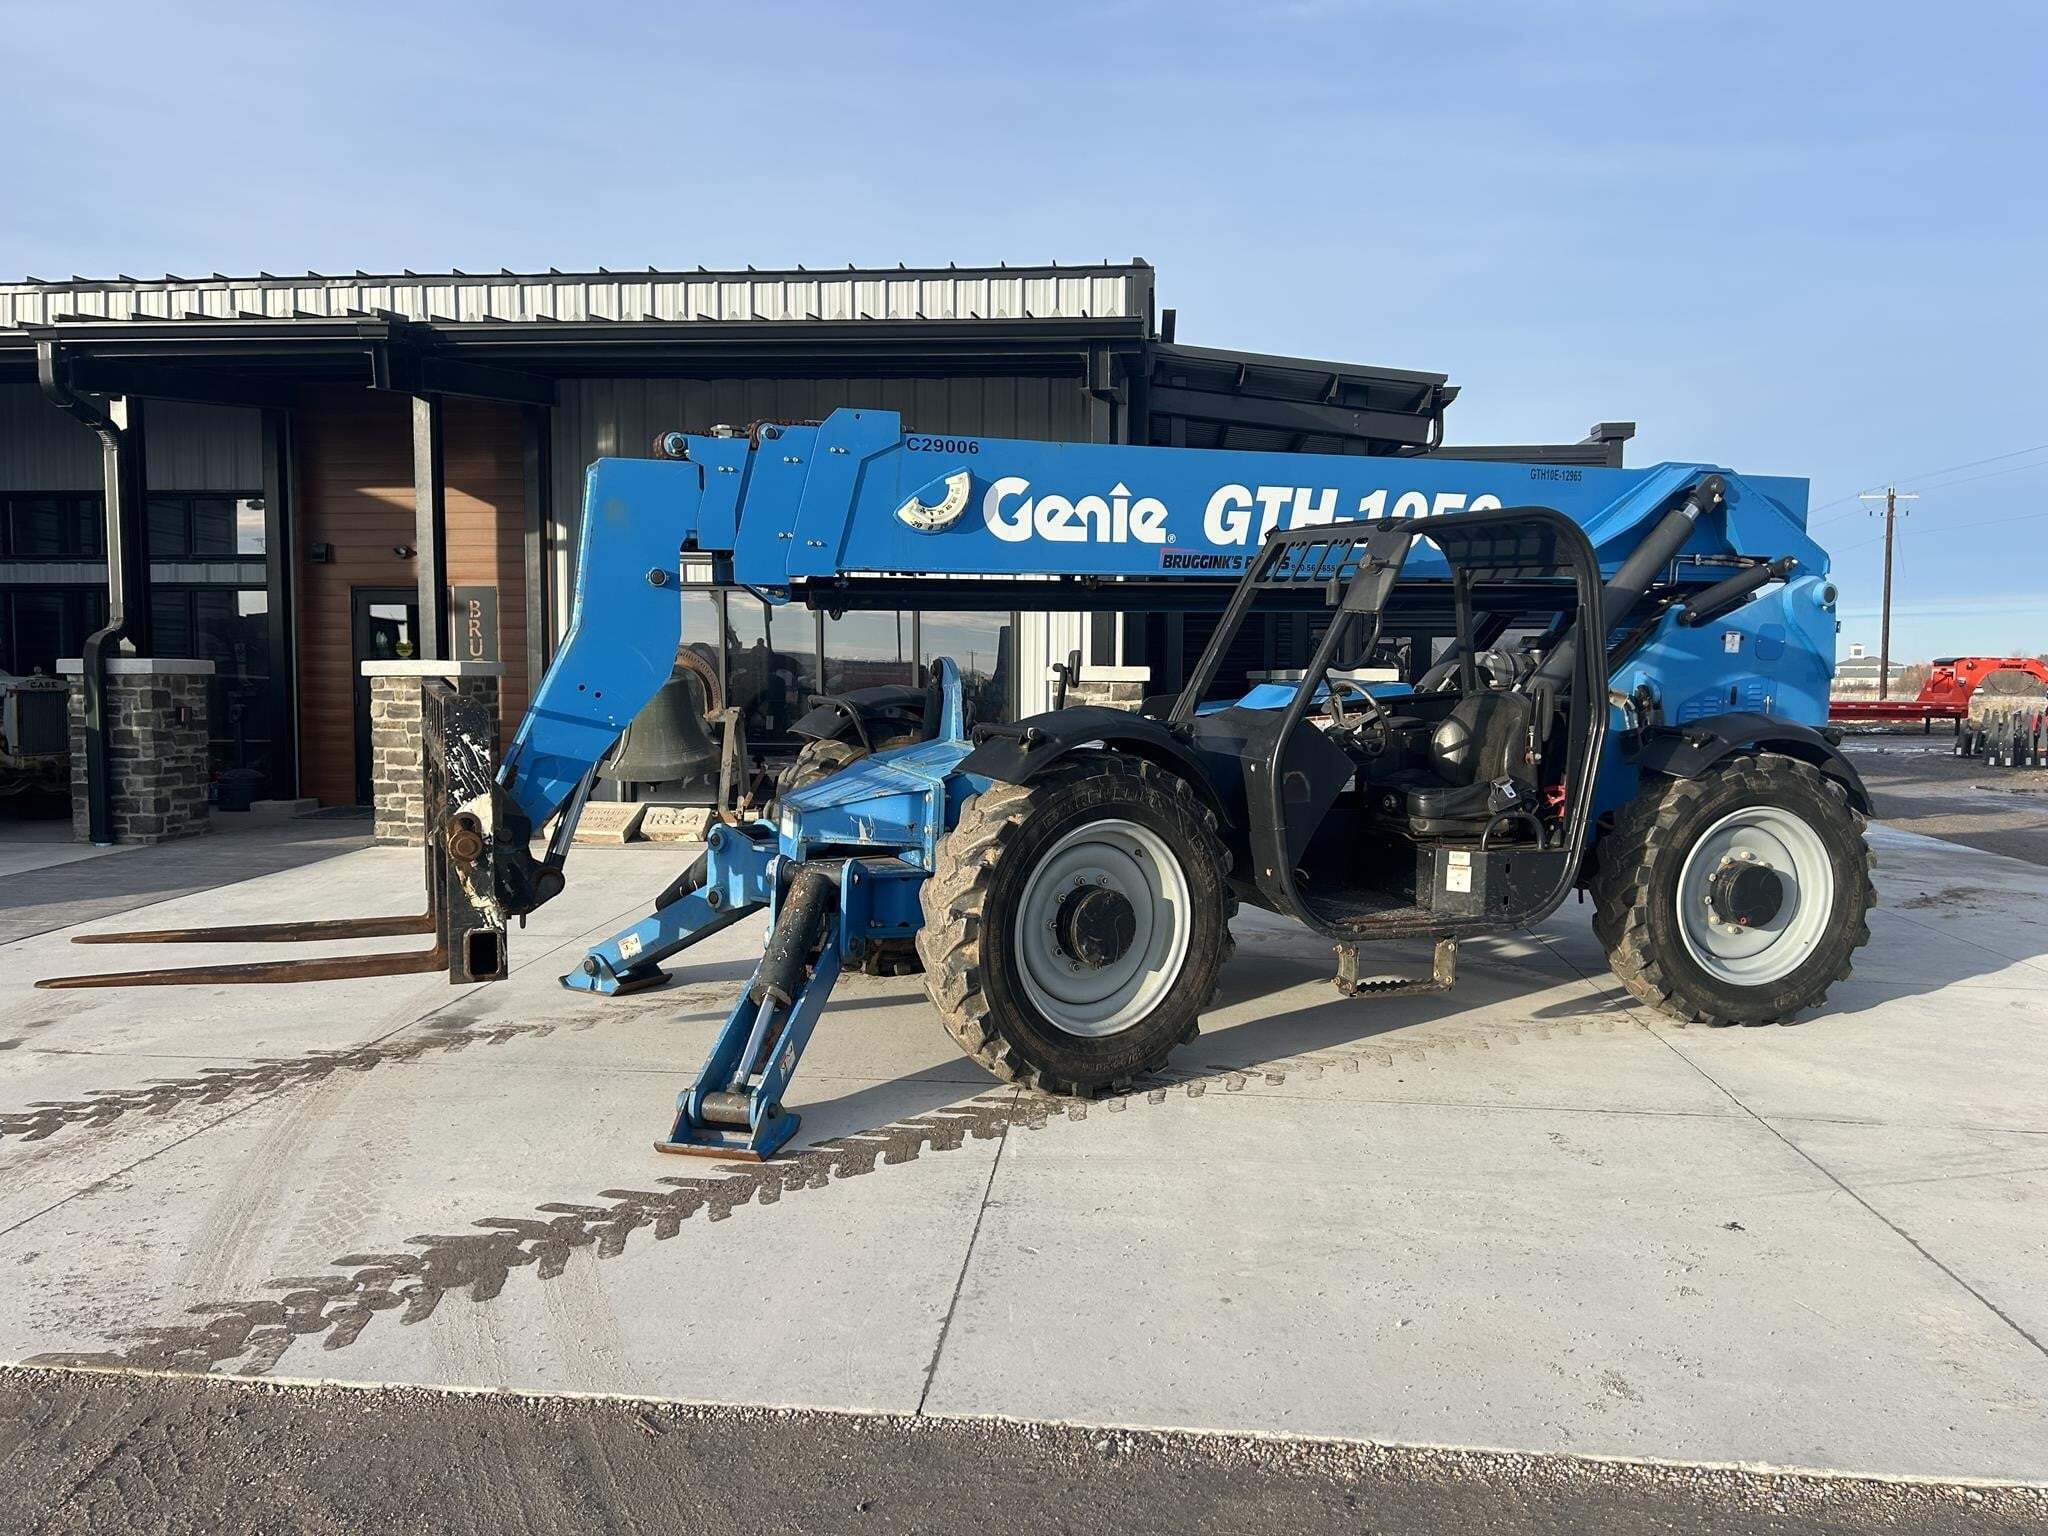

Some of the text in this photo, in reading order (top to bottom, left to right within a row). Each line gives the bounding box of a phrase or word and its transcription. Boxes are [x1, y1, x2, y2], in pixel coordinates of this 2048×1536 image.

[906, 437, 980, 455] C29006
[1530, 468, 1583, 482] GTH10E-12965
[983, 477, 1168, 544] Genie
[1162, 553, 1243, 570] BRUGGINK'S
[468, 600, 484, 661] BRU
[30, 680, 58, 689] CASE
[648, 813, 700, 827] 1884
